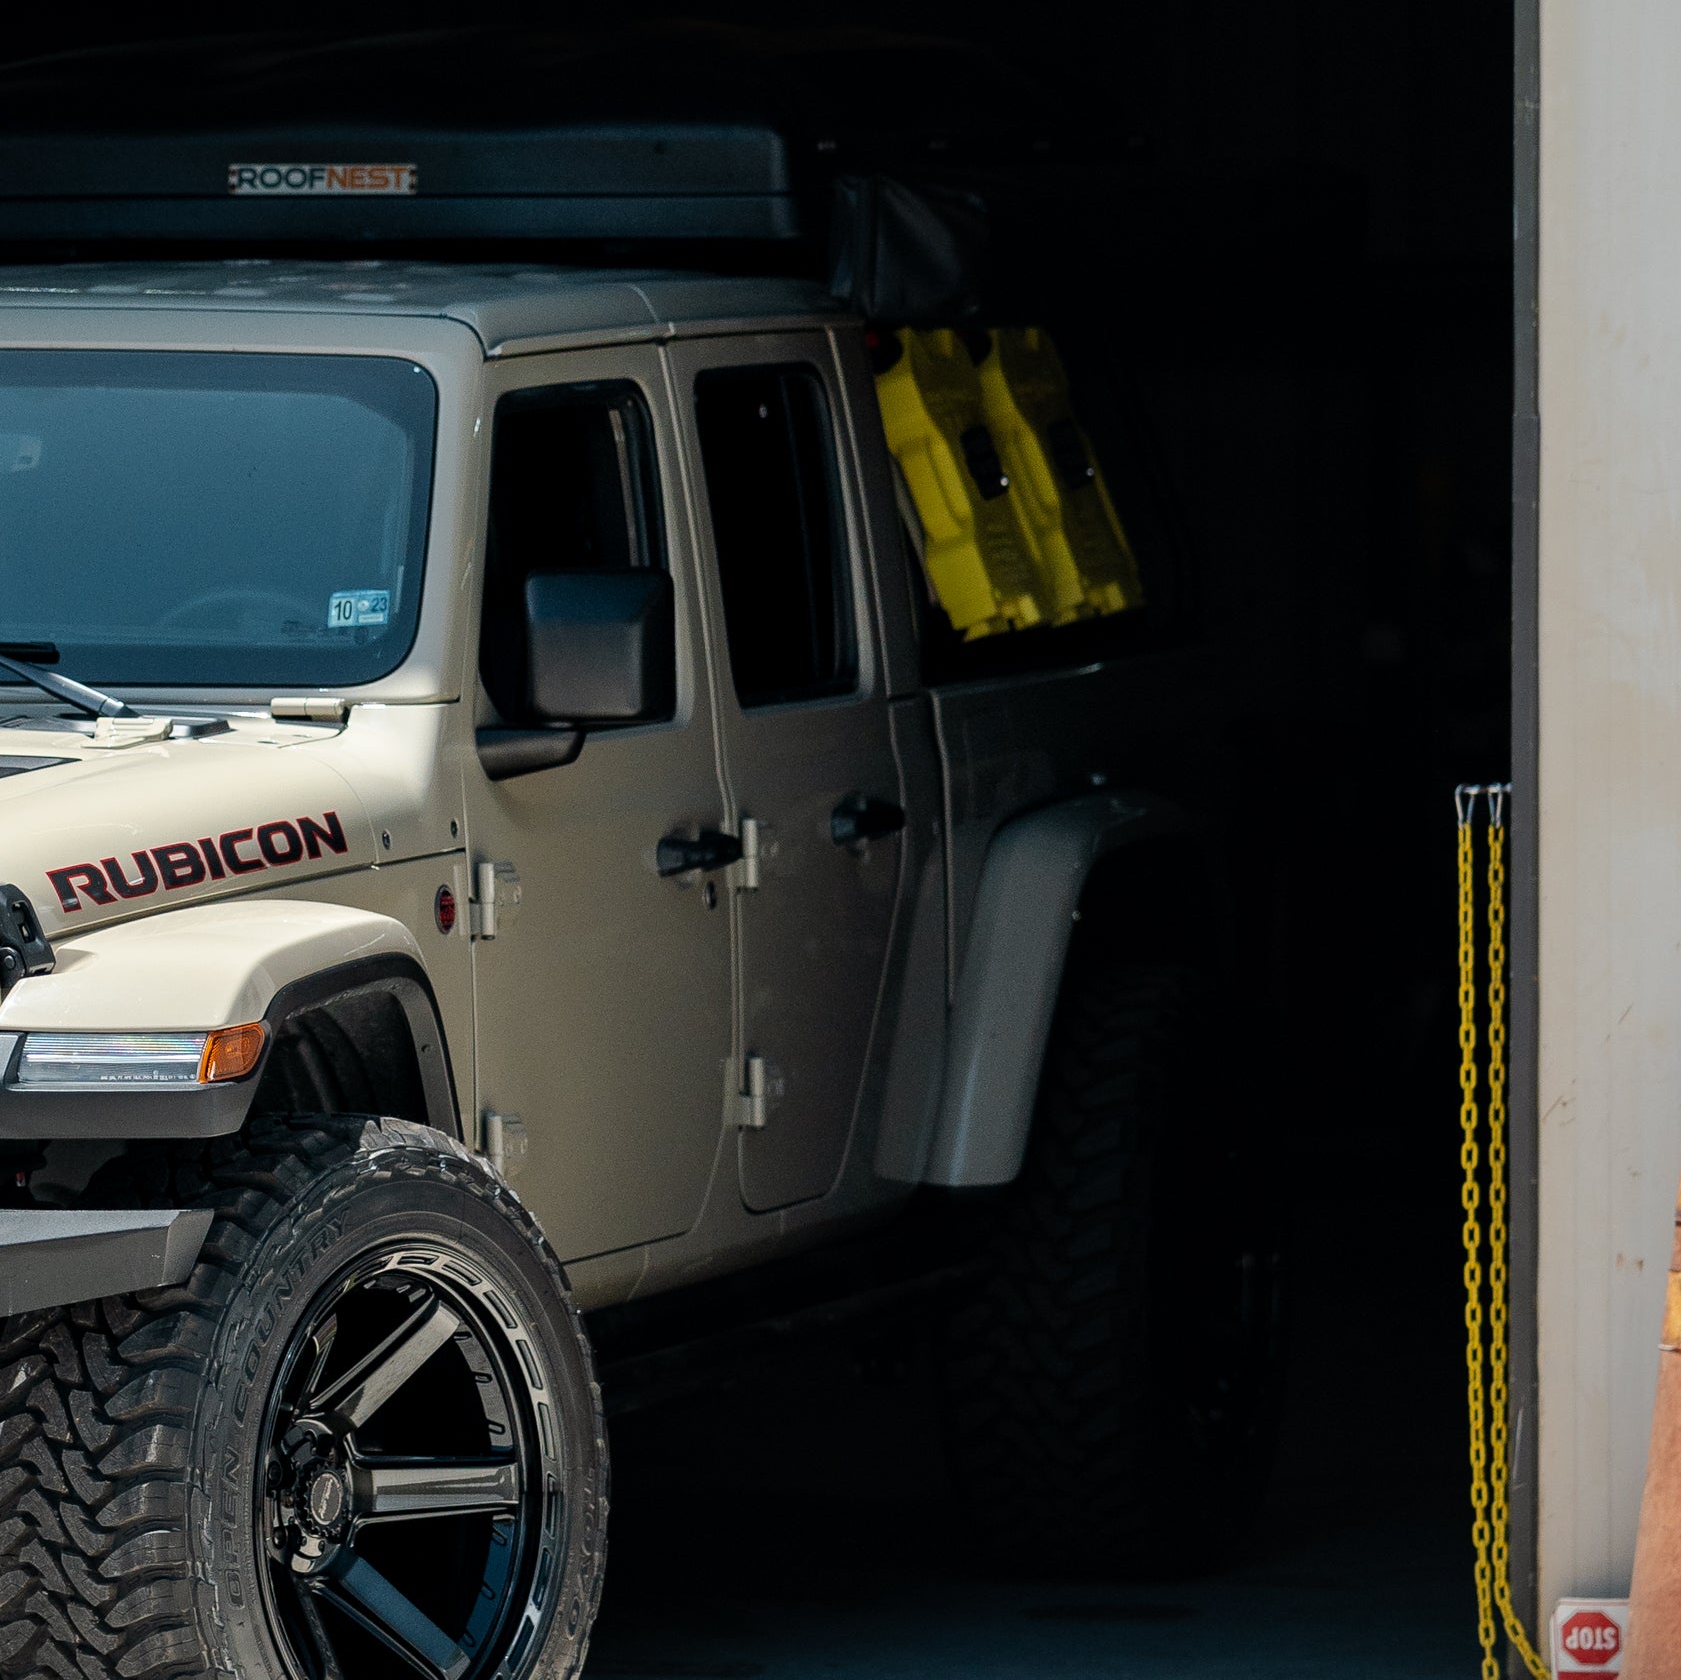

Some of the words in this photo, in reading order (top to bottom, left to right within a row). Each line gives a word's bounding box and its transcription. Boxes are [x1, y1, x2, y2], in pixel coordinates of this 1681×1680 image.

[236, 167, 410, 190] ROOFNEST
[334, 600, 353, 621] 10
[371, 597, 388, 613] 23
[45, 810, 348, 914] RUBICON
[232, 1205, 351, 1428] COUNTRY
[220, 1444, 245, 1610] OPEN
[1566, 1626, 1617, 1650] STOP
